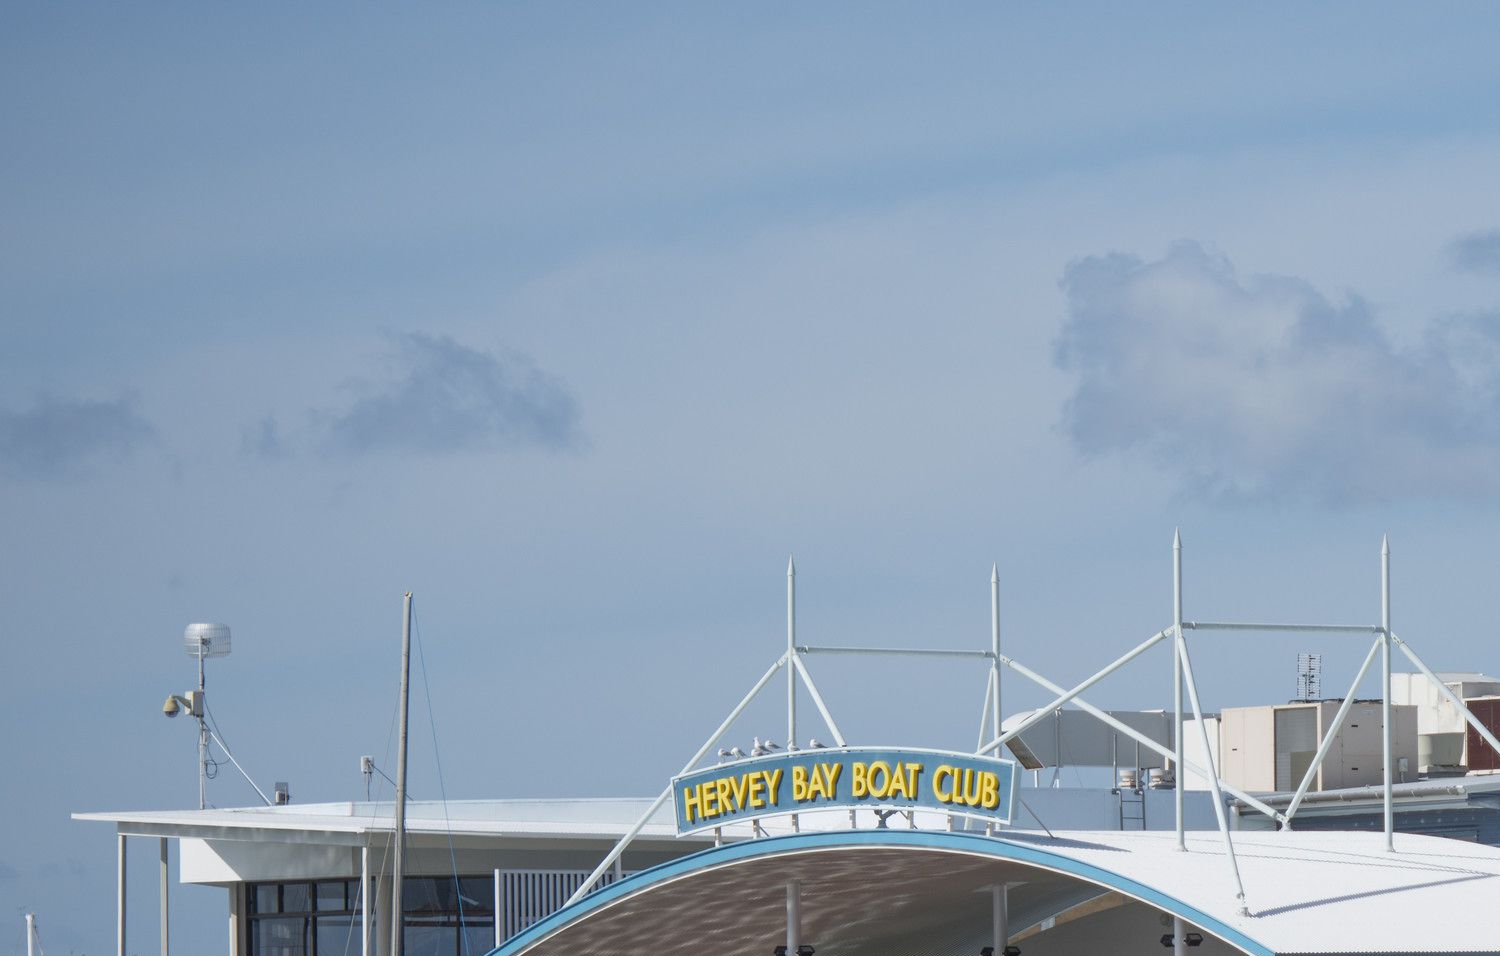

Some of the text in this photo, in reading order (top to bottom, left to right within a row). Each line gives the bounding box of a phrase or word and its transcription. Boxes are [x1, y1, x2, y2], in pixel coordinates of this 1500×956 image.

[684, 760, 1000, 823] HERVEY BAY BOAT CLUB
